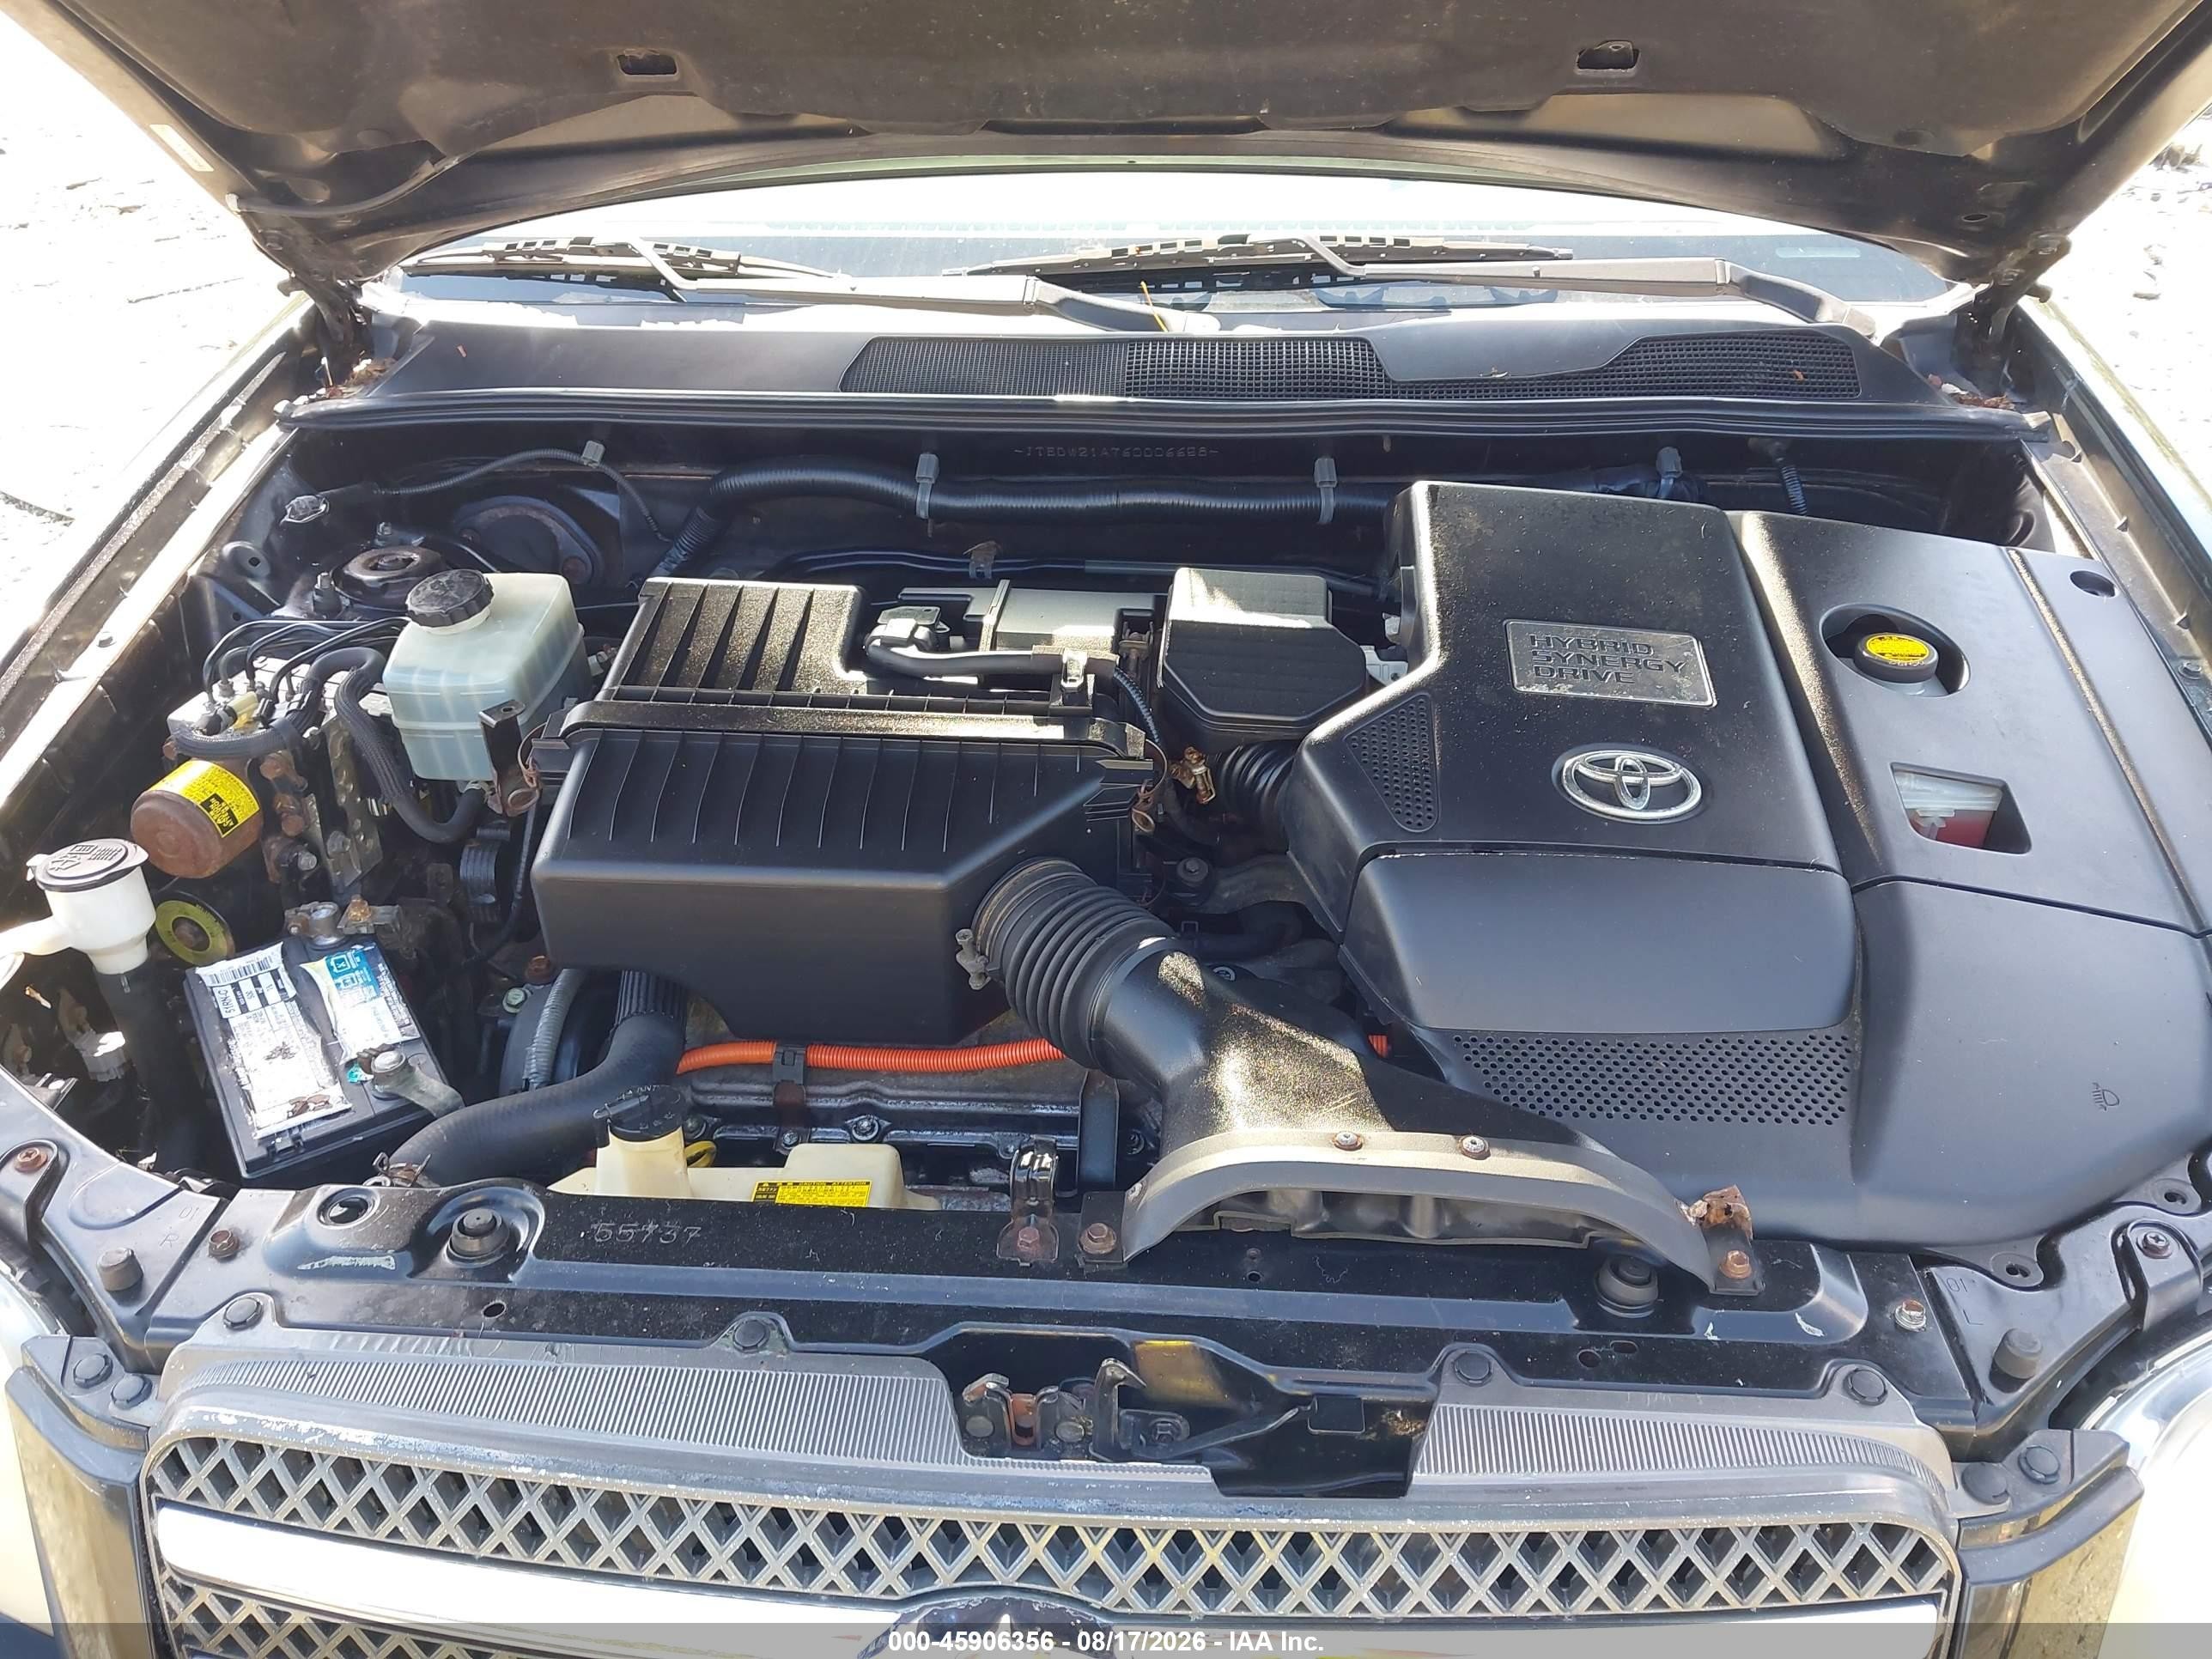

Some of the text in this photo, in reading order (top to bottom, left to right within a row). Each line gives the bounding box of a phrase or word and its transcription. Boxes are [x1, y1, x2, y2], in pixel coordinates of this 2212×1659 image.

[1529, 634, 1655, 657] HYBRID
[1531, 649, 1687, 674] SYNERGY
[1534, 665, 1636, 684] DRIVE
